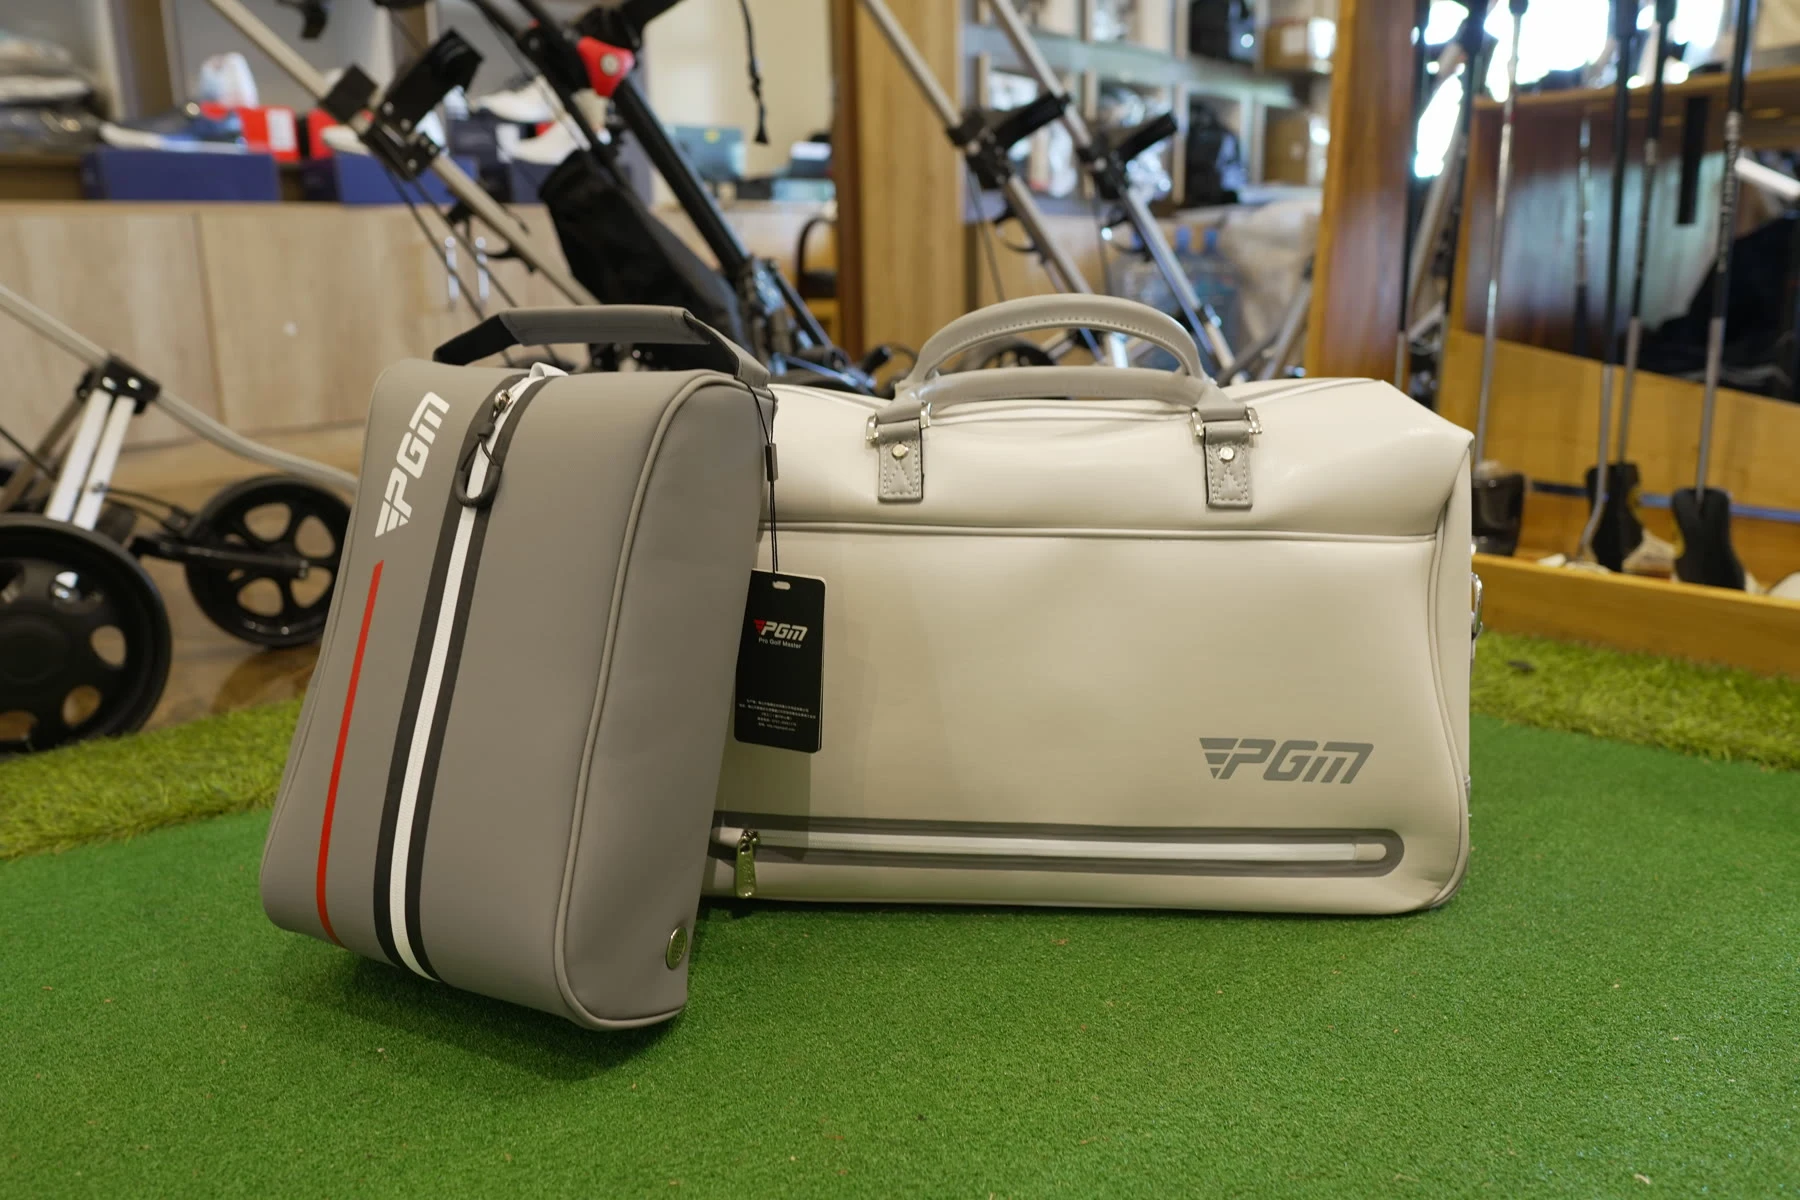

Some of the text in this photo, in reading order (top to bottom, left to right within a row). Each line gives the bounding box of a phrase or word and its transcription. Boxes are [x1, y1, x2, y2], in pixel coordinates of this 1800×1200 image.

[384, 391, 450, 519] PGM
[758, 637, 768, 645] Pro
[782, 641, 802, 649] Master
[761, 621, 808, 641] PGM
[1217, 738, 1374, 785] PGM
